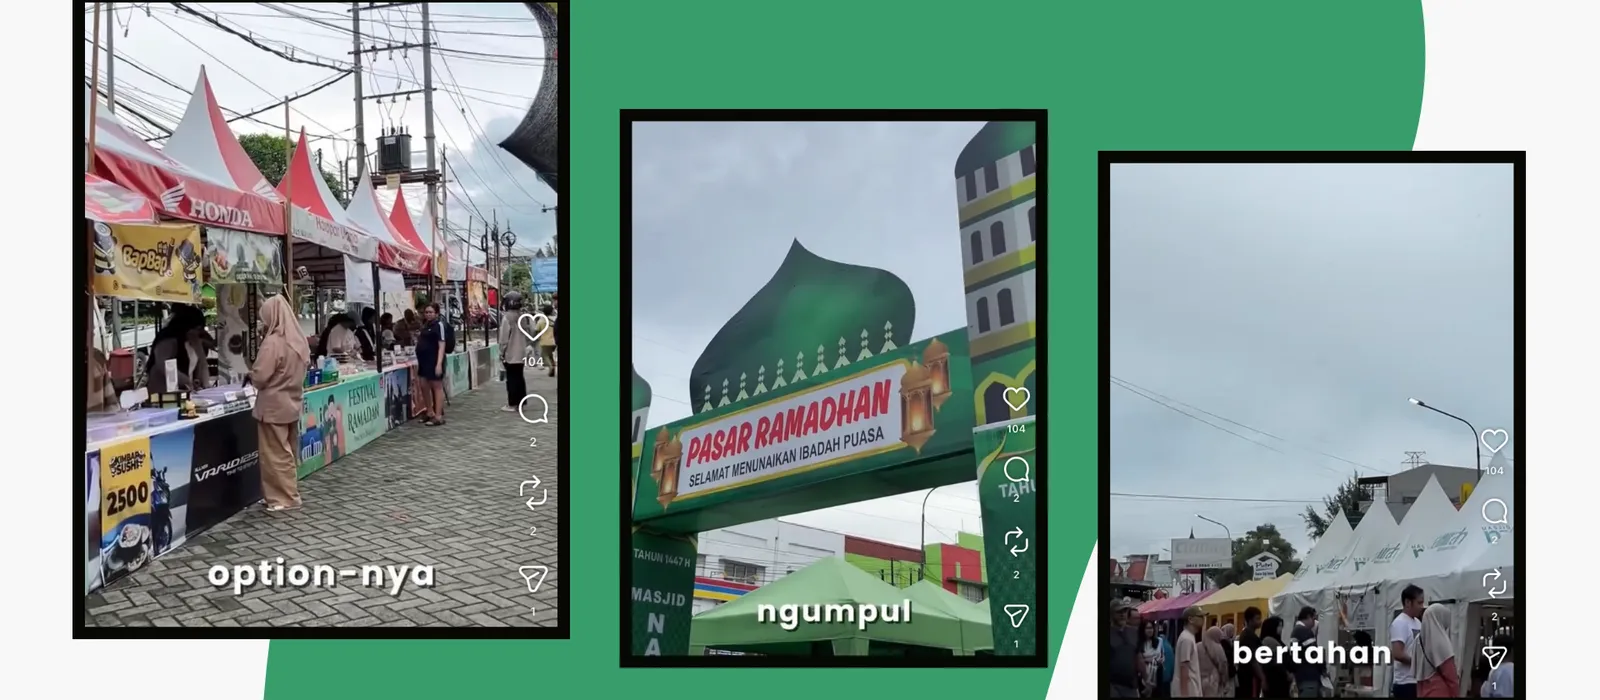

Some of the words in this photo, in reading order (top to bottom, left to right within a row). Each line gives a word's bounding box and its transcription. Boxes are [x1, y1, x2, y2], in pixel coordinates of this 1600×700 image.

[188, 199, 254, 228] HONDA
[122, 245, 168, 277] BapBap
[348, 382, 377, 407] FESTIVAL
[347, 402, 380, 434] RAMADAN
[685, 422, 752, 468] PASAR
[754, 378, 891, 447] RAMADHAN
[116, 460, 140, 476] SUSHI
[688, 467, 731, 488] SELAMAT
[731, 449, 797, 477] MENUNAIKAN
[799, 442, 841, 461] IBADAH
[843, 426, 885, 450] PUASA
[106, 481, 148, 517] 2500
[633, 548, 664, 564] TAHUN
[664, 554, 683, 566] 1447
[684, 558, 691, 568] H
[631, 586, 686, 607] MASJID
